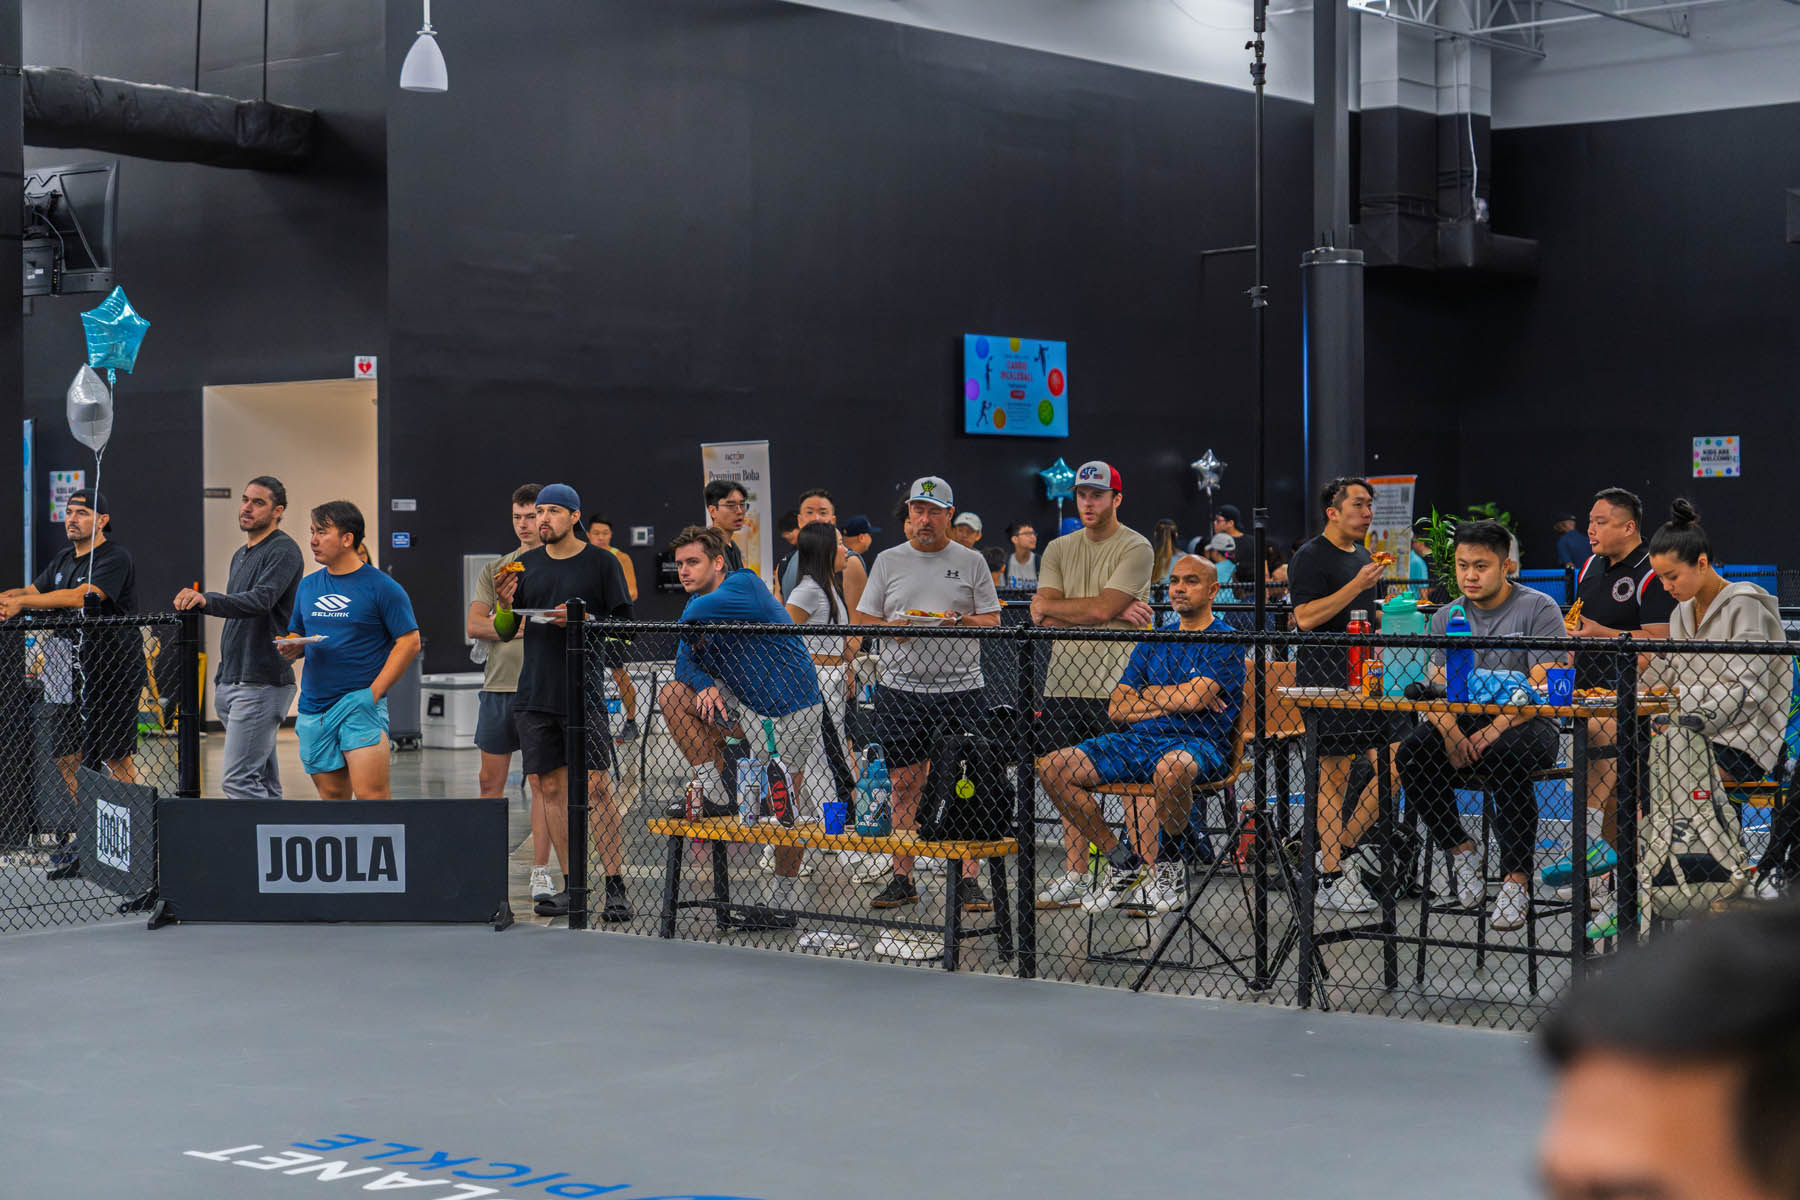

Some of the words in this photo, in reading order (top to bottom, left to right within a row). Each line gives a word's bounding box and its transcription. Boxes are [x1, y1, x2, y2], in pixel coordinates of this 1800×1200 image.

[708, 470, 742, 481] Premium
[742, 469, 760, 481] Boba
[265, 835, 399, 883] JOOLA
[183, 1145, 504, 1200] LANET
[291, 1133, 633, 1200] PICKLE
